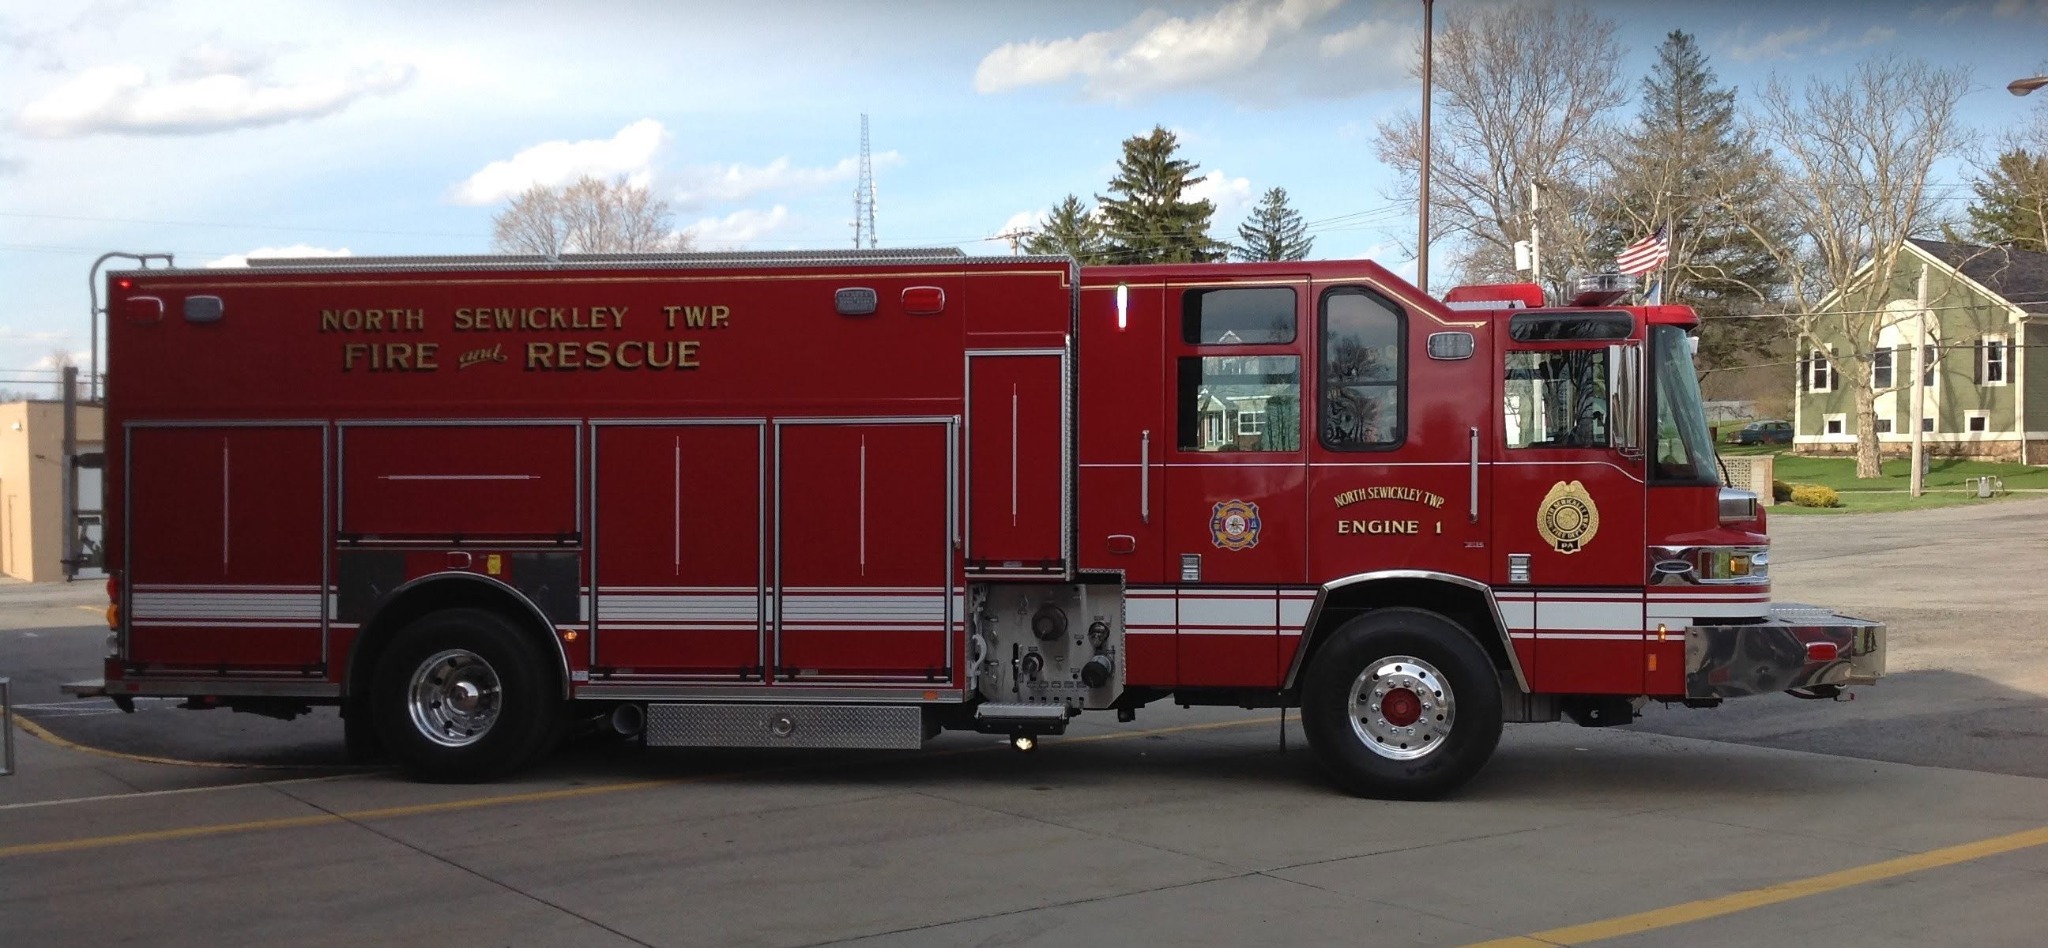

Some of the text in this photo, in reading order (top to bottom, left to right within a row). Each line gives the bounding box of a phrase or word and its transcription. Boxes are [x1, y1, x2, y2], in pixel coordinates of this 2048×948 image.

[320, 305, 731, 332] NORTH SEWICKLEY TWP.
[344, 340, 701, 371] FIRE and RESCUE
[1334, 488, 1366, 509] NORTH
[1367, 486, 1423, 502] SEWICKLEY
[1338, 520, 1442, 534] ENGINE 1
